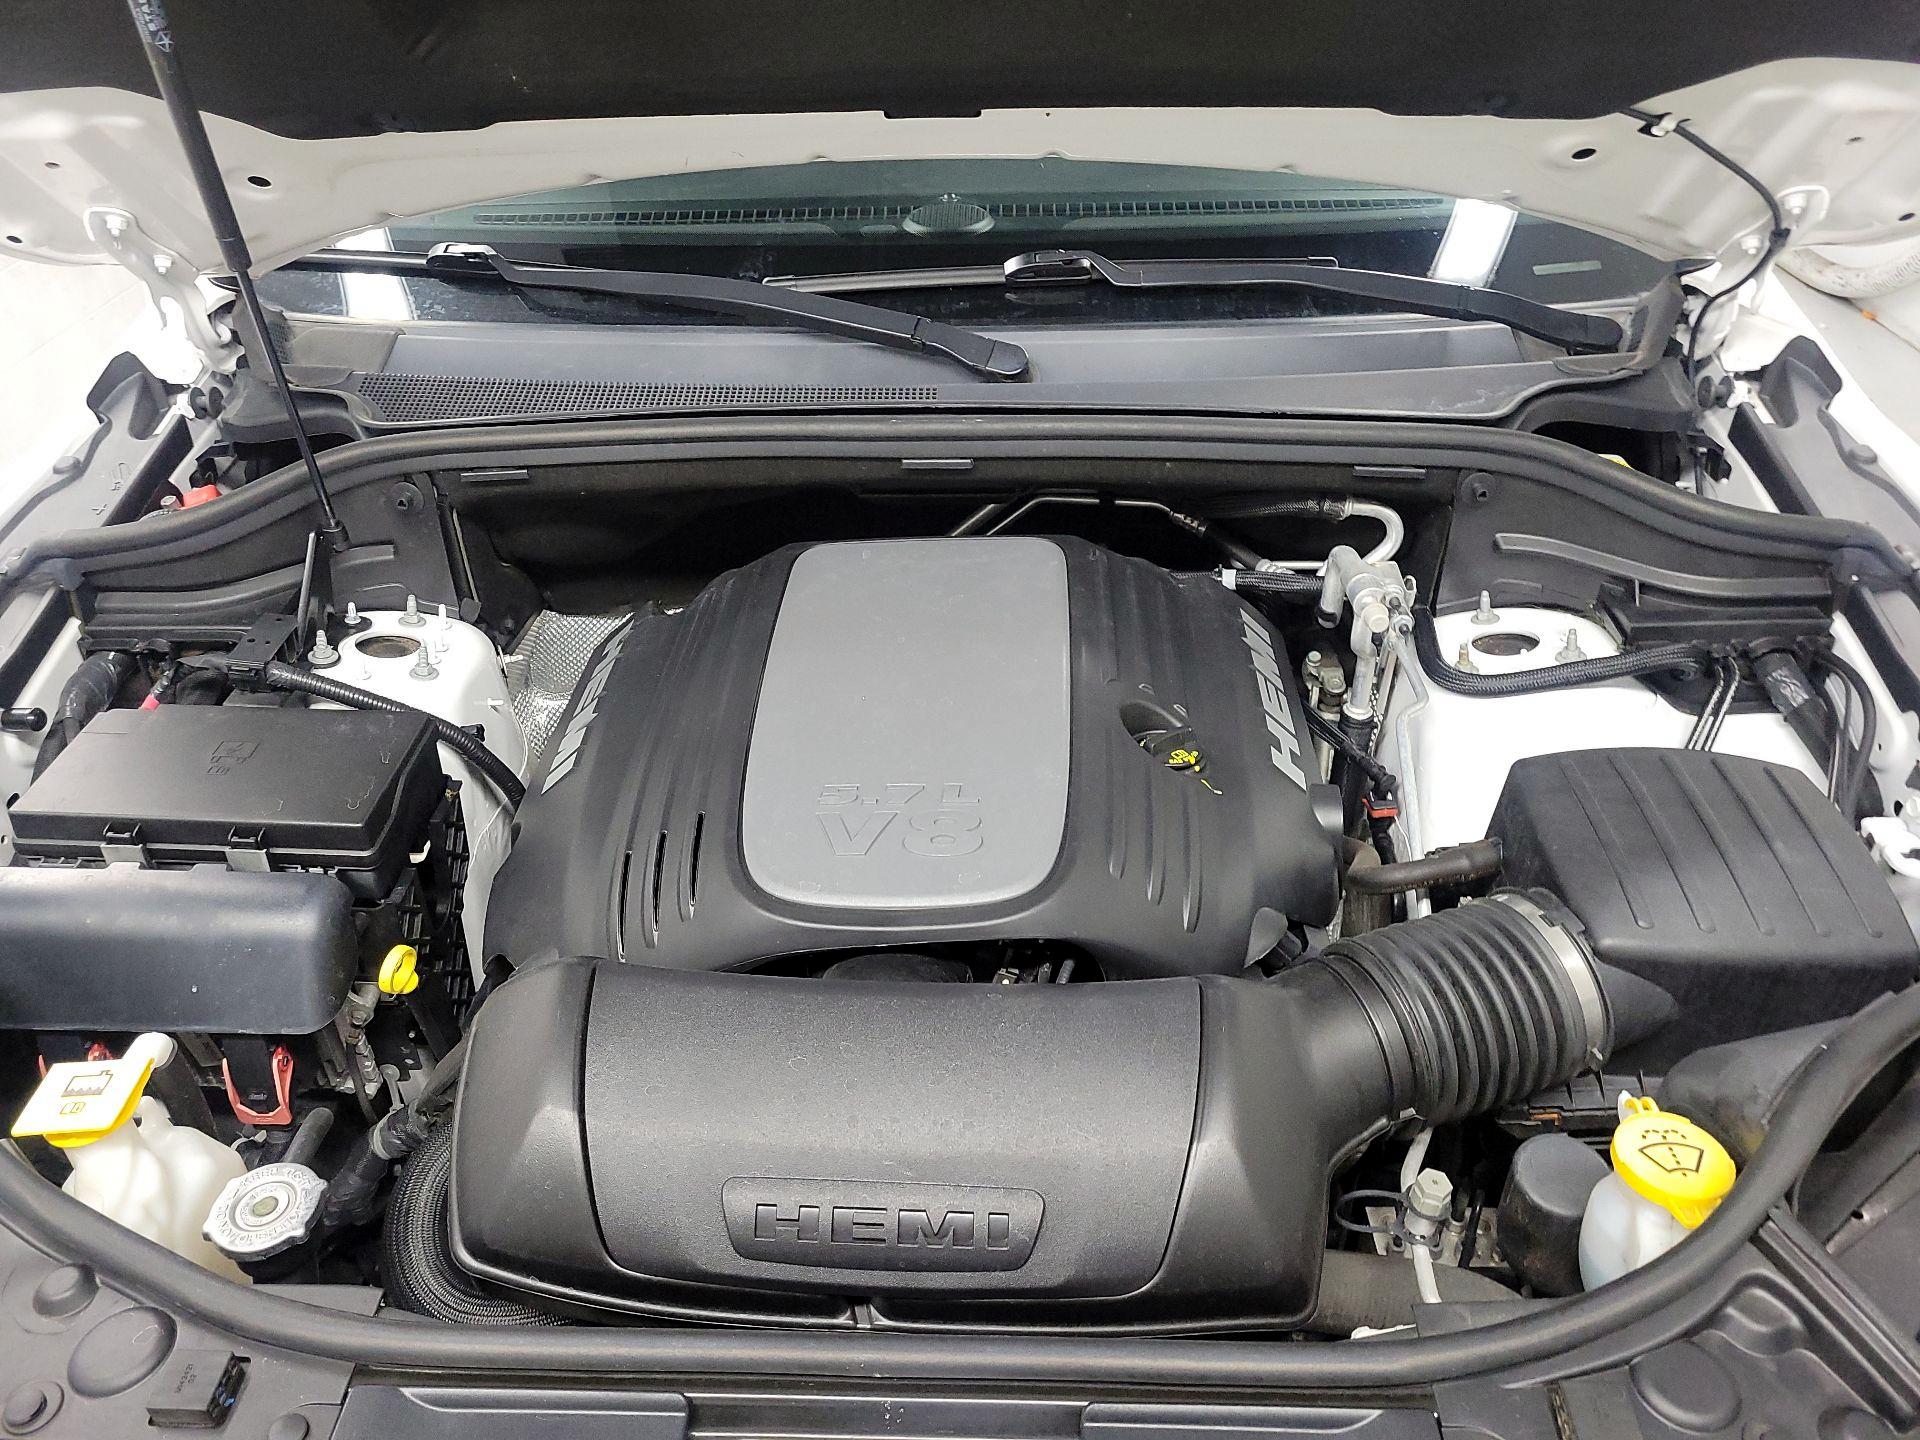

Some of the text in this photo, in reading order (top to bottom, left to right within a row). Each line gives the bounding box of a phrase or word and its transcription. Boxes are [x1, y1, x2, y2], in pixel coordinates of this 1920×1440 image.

[542, 621, 634, 795] HEMI
[1240, 608, 1307, 791] HEMI
[816, 811, 984, 857] V8
[755, 1203, 1010, 1251] HEMI
